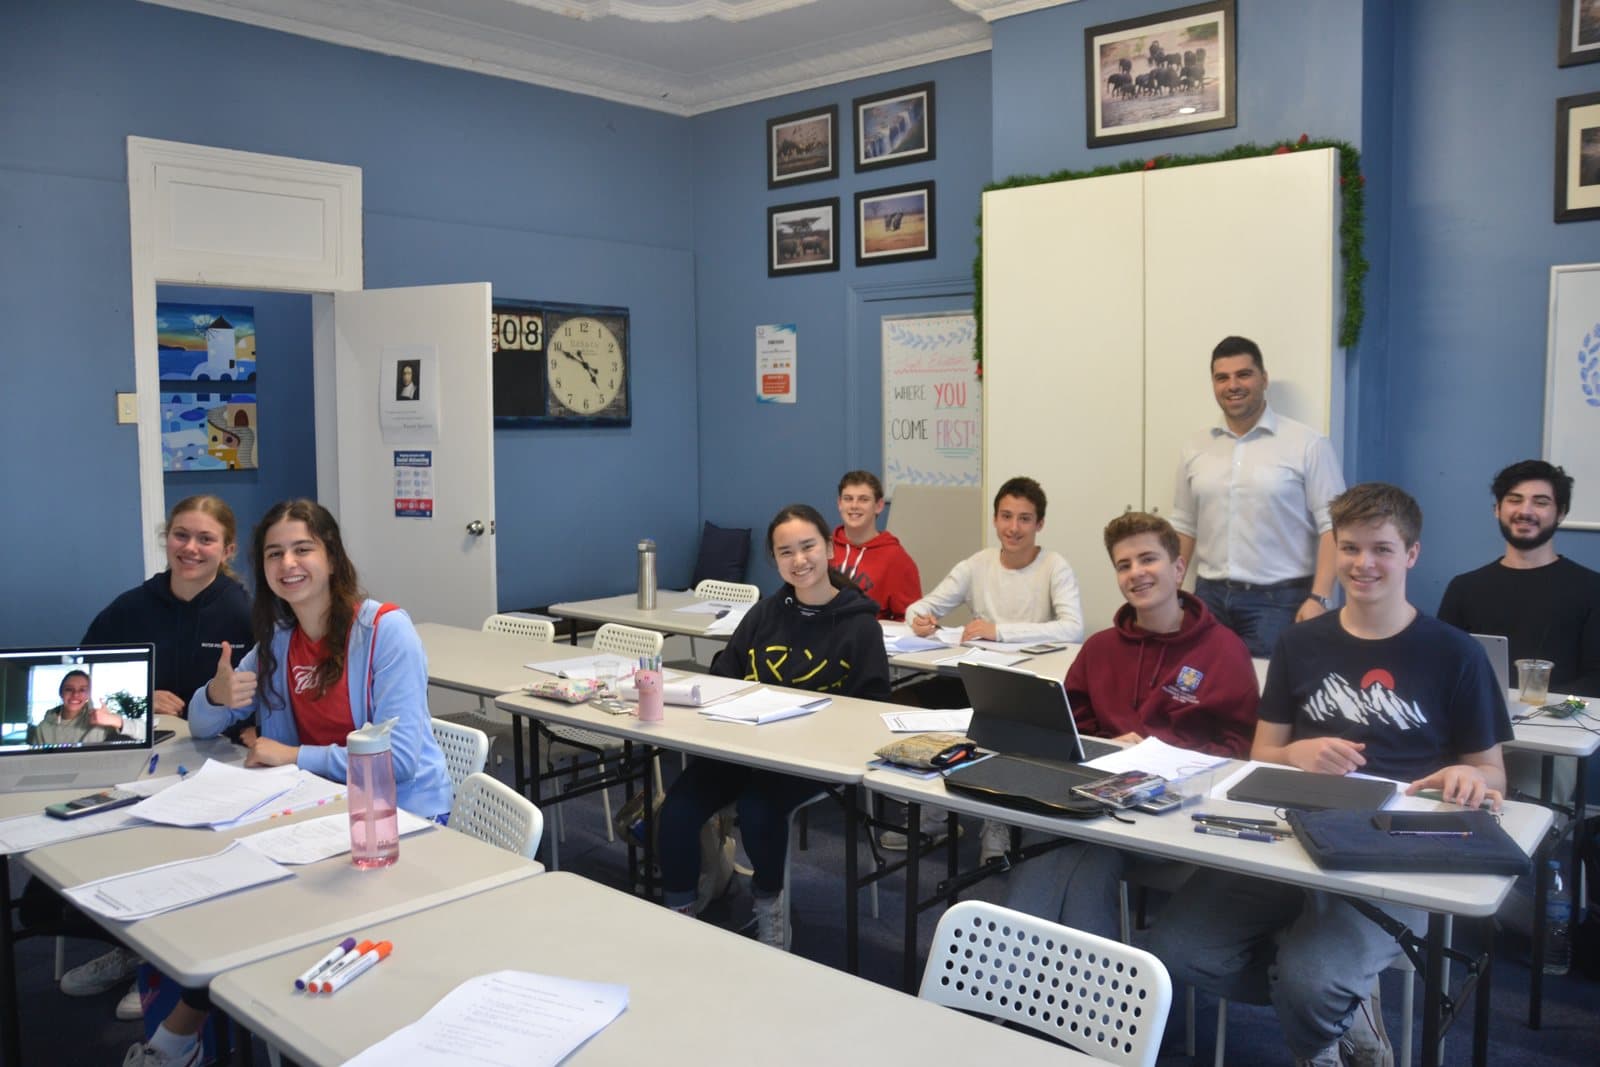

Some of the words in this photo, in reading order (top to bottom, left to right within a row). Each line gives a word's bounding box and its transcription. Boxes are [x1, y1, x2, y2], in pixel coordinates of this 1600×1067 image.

[502, 319, 540, 346] 08
[564, 327, 572, 337] 11
[579, 322, 589, 333] 12
[553, 341, 562, 351] 10
[608, 343, 614, 353] 2
[551, 359, 557, 370] 9
[612, 361, 618, 373] 3
[555, 379, 562, 389] 8
[608, 378, 614, 390] 4
[567, 393, 573, 405] 7
[599, 394, 605, 405] 5
[894, 384, 926, 401] WHERE
[933, 382, 966, 408] YOU
[583, 399, 589, 410] 6
[891, 418, 928, 440] COME
[936, 419, 976, 449] FIRST!
